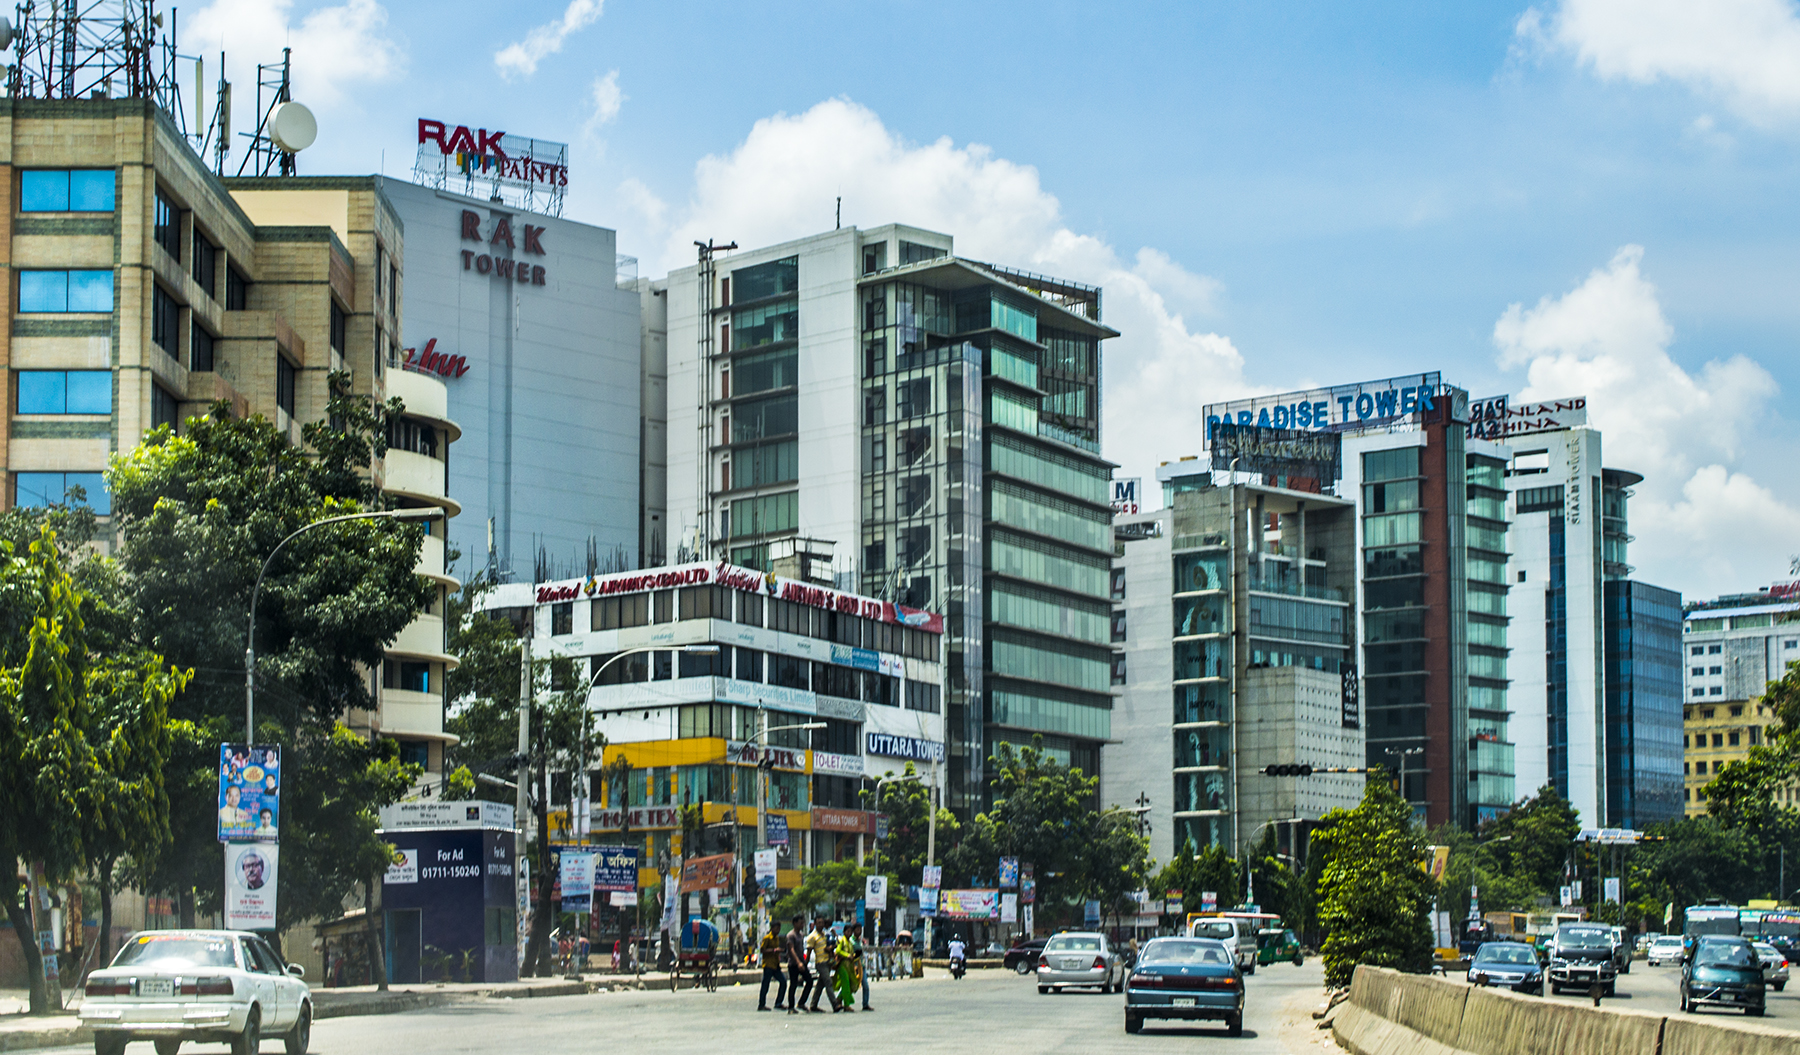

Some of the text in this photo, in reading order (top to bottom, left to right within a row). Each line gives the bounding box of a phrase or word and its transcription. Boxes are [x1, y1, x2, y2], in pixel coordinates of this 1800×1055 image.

[417, 117, 507, 160] RAK
[499, 157, 569, 187] PAINTS
[460, 248, 546, 286] TOWER
[1206, 384, 1435, 441] PARADISE TOWER
[861, 600, 882, 620] LTD
[728, 679, 751, 699] Sharp
[752, 683, 788, 702] Securities
[773, 747, 795, 766] TEX
[869, 733, 944, 761] UTTARA TOWER
[814, 752, 841, 769] TO-LET
[647, 808, 678, 826] TEX
[822, 814, 858, 827] UTTARA TOWER
[437, 848, 464, 862] For Ad
[493, 846, 501, 858] For
[606, 853, 636, 869] অফিস
[422, 864, 480, 879] 01711-150240
